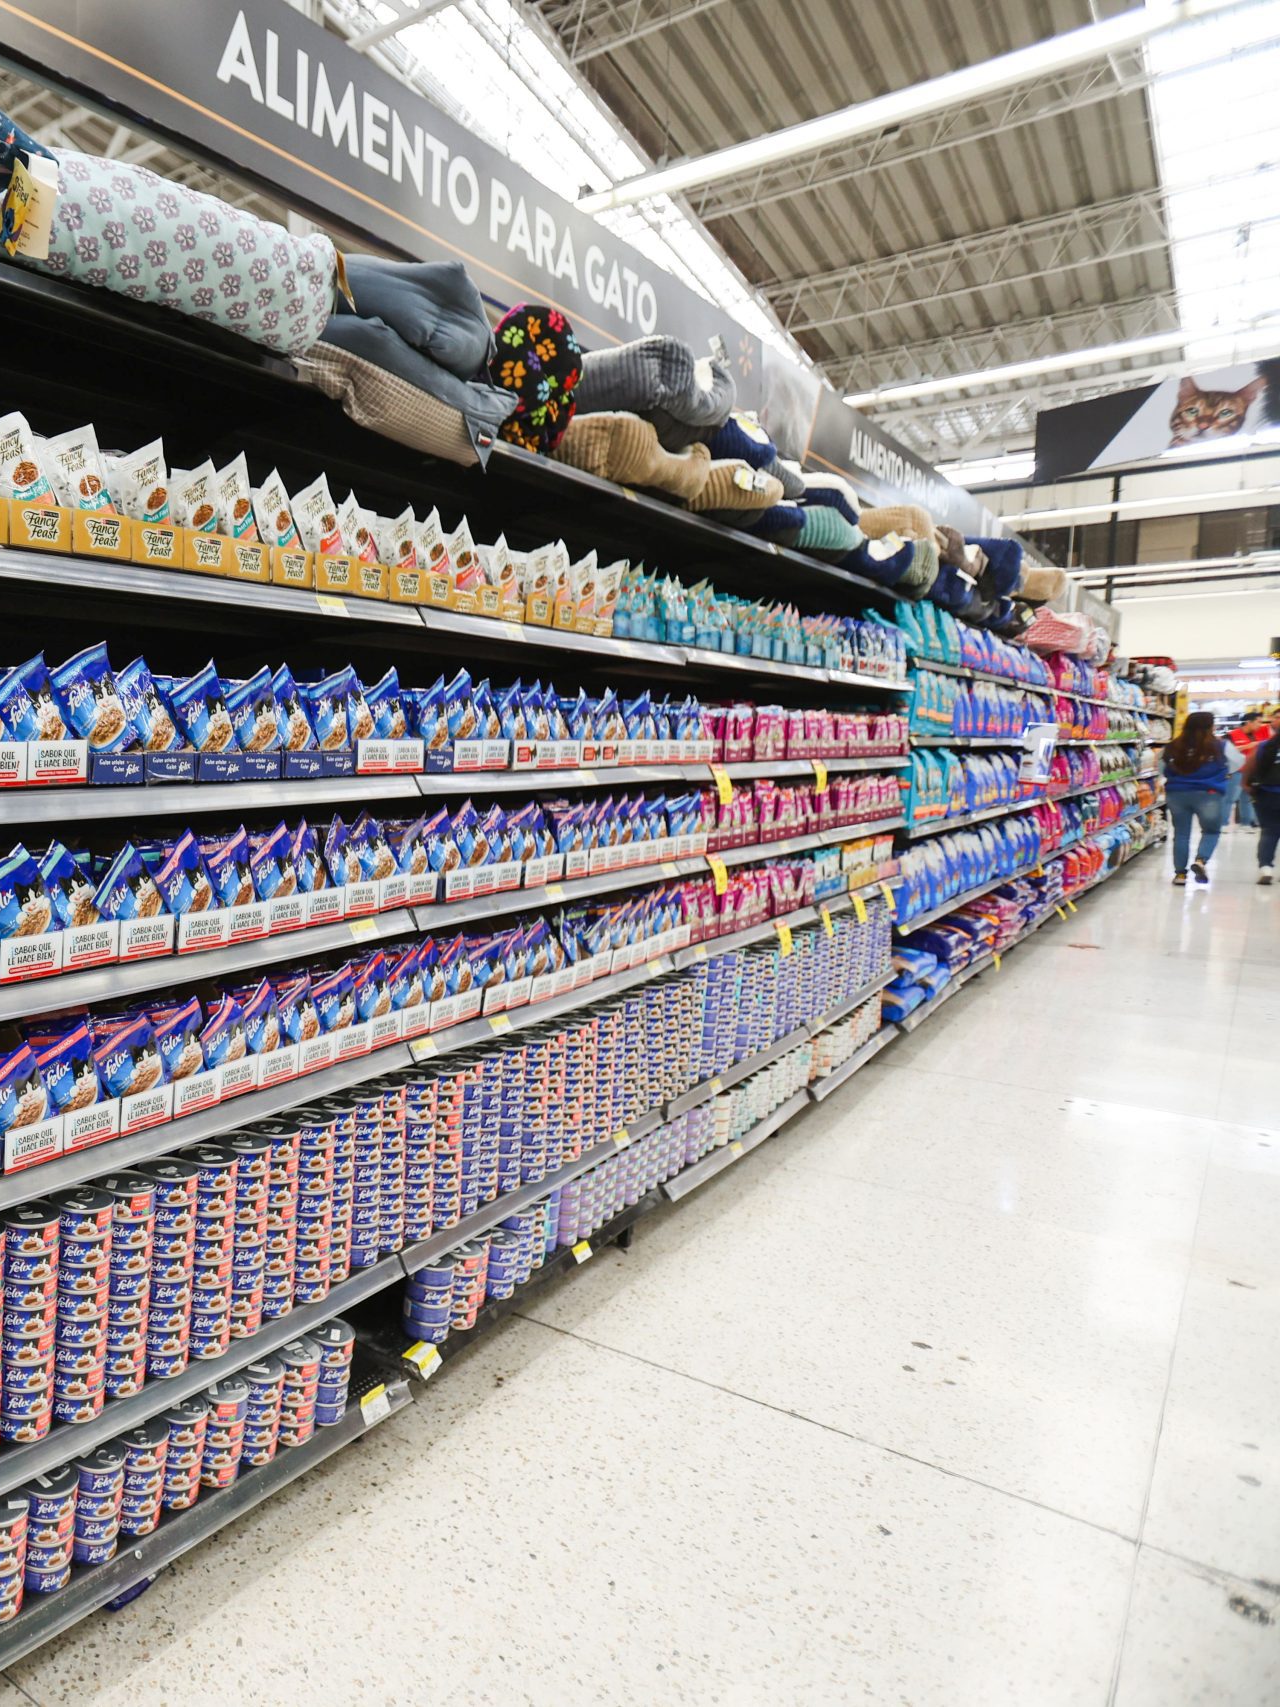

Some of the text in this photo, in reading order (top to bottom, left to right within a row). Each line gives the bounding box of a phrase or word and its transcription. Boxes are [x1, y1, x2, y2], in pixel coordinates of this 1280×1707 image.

[217, 9, 658, 335] ALIMENTO PARA GATO
[24, 510, 59, 528] Fancy
[30, 525, 58, 540] Feast
[86, 519, 119, 538] Fancy
[93, 534, 119, 548] Feast
[143, 530, 171, 548] Fancy
[193, 538, 220, 555] Fancy
[149, 544, 172, 558] Feast
[2, 751, 15, 760] QUE
[0, 761, 20, 771] BIEN!
